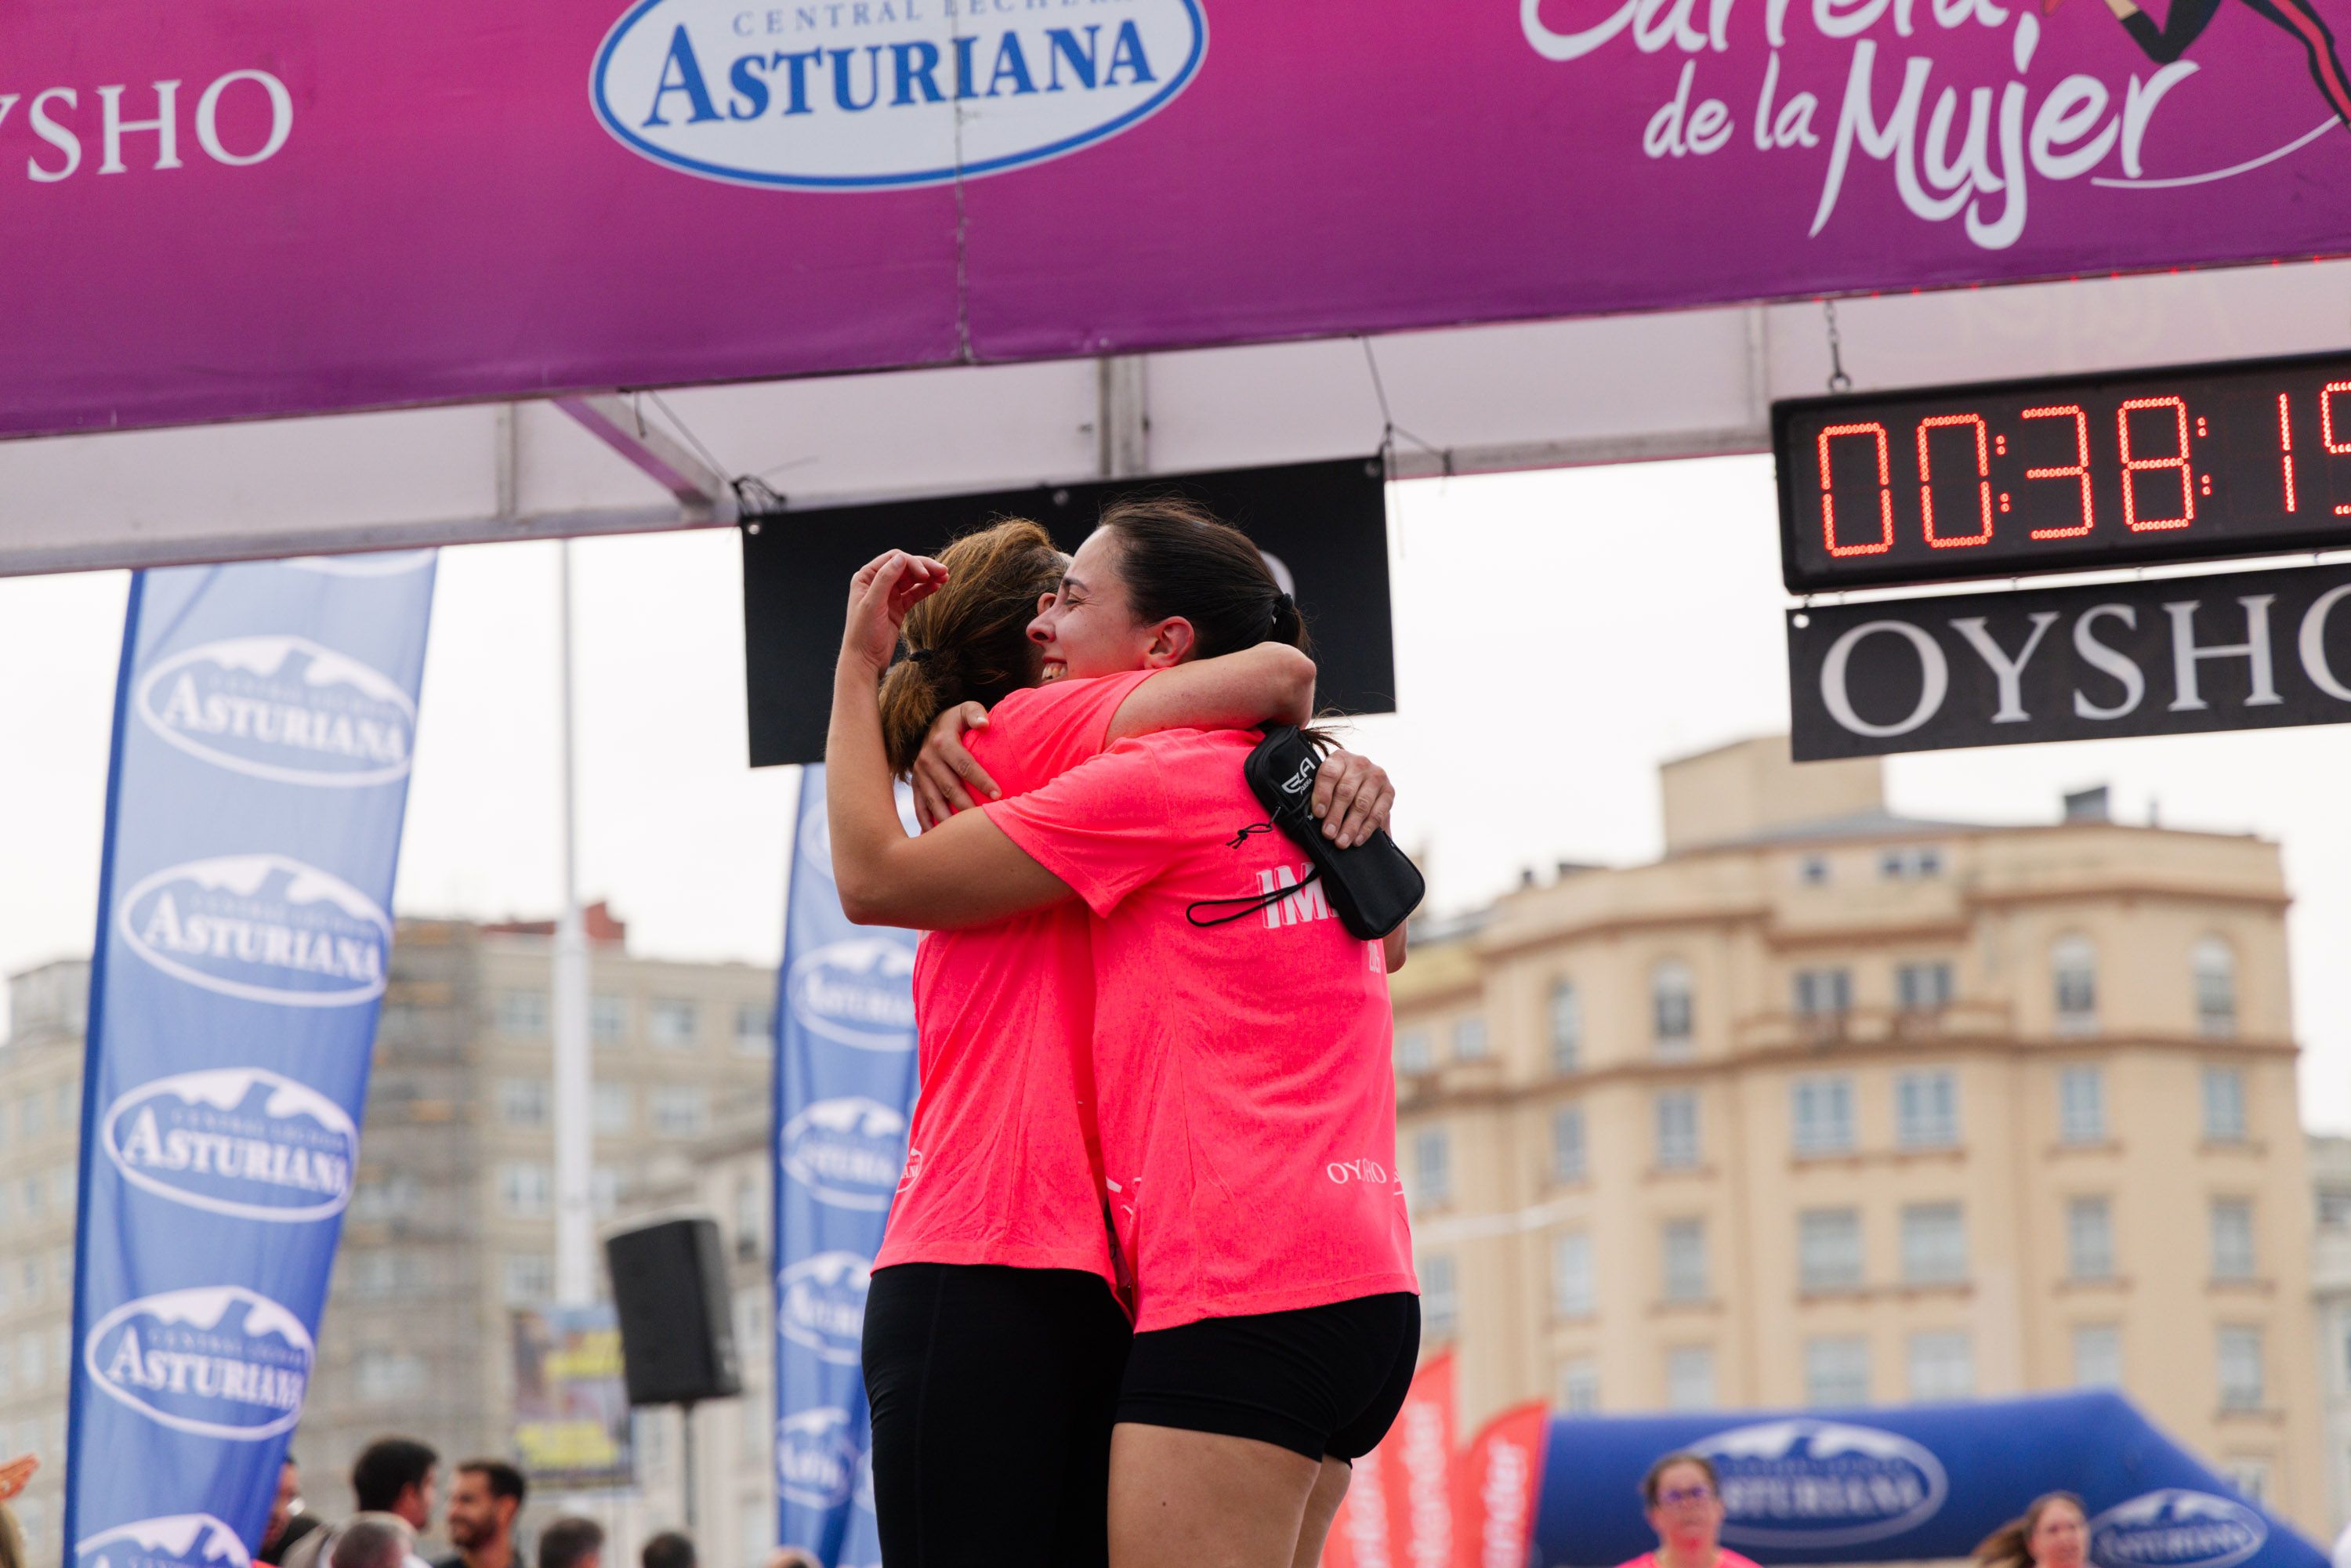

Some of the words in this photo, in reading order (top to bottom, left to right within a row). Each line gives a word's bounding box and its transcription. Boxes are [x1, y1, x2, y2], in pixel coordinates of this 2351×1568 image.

[639, 20, 1159, 129] ASTURIANA
[731, 0, 923, 37] CENTRAL
[0, 68, 294, 183] SHO
[1643, 60, 1733, 158] de
[1754, 50, 1819, 150] la
[1807, 12, 2200, 250] Mujer
